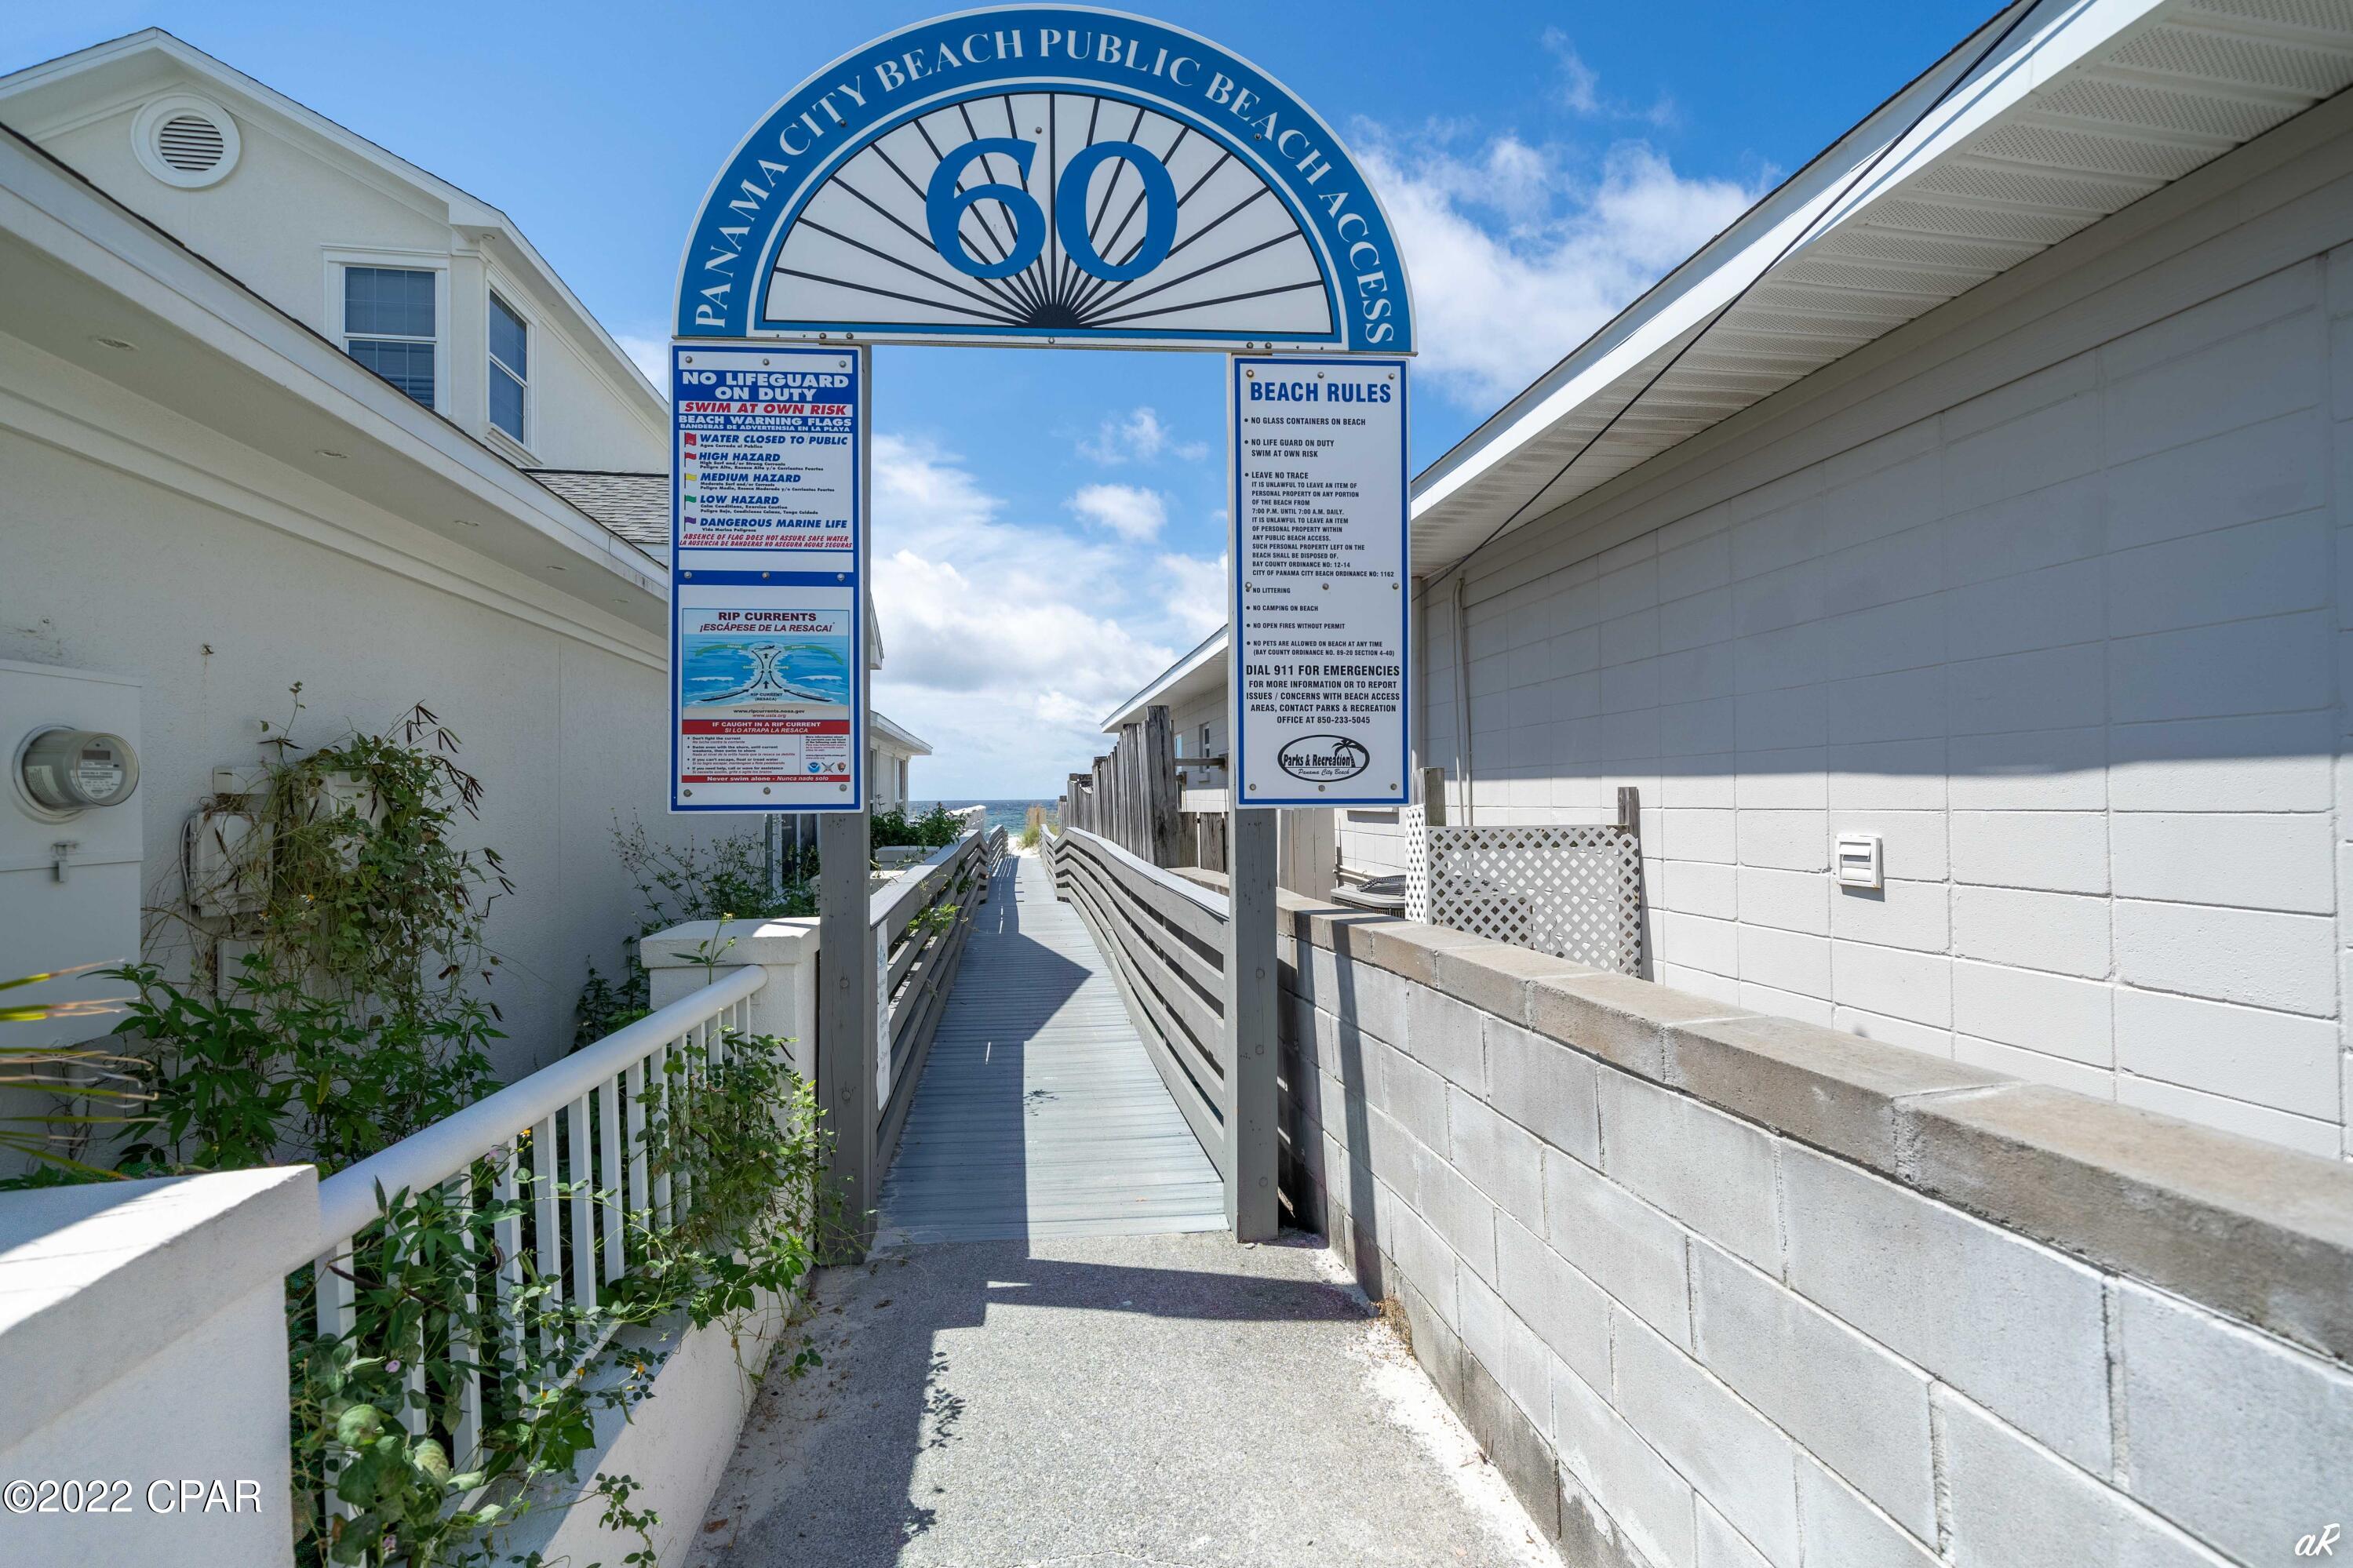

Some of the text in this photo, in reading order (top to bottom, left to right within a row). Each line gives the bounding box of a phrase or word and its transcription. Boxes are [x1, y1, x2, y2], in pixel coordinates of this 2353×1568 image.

[695, 29, 1394, 344] PANAMA CITY BEACH PUBLIC BEACH ACCESS
[926, 137, 1178, 282] 60
[683, 372, 849, 387] NO LIFEGUARD
[715, 387, 817, 401] ON DUTY
[1251, 382, 1391, 402] BEACH RULES
[685, 402, 847, 416] SWIM AT OWN RISK
[679, 416, 852, 427] BEACH WARNING FLAGS
[700, 434, 740, 443] WATER
[743, 435, 786, 444] CLOSED
[808, 436, 848, 445] PUBLIC
[698, 452, 781, 462] HIGH HAZARD
[700, 473, 801, 482] MEDIUM HAZARD
[700, 495, 779, 504] LOW HAZARD
[700, 518, 772, 527] DANGEROUS
[775, 519, 821, 528] MARINE
[719, 612, 817, 621] RIP CURRENTS
[1246, 665, 1400, 676] DIAL 911 FOR EMERGENCIES
[1284, 754, 1350, 766] Parks & Recreation
